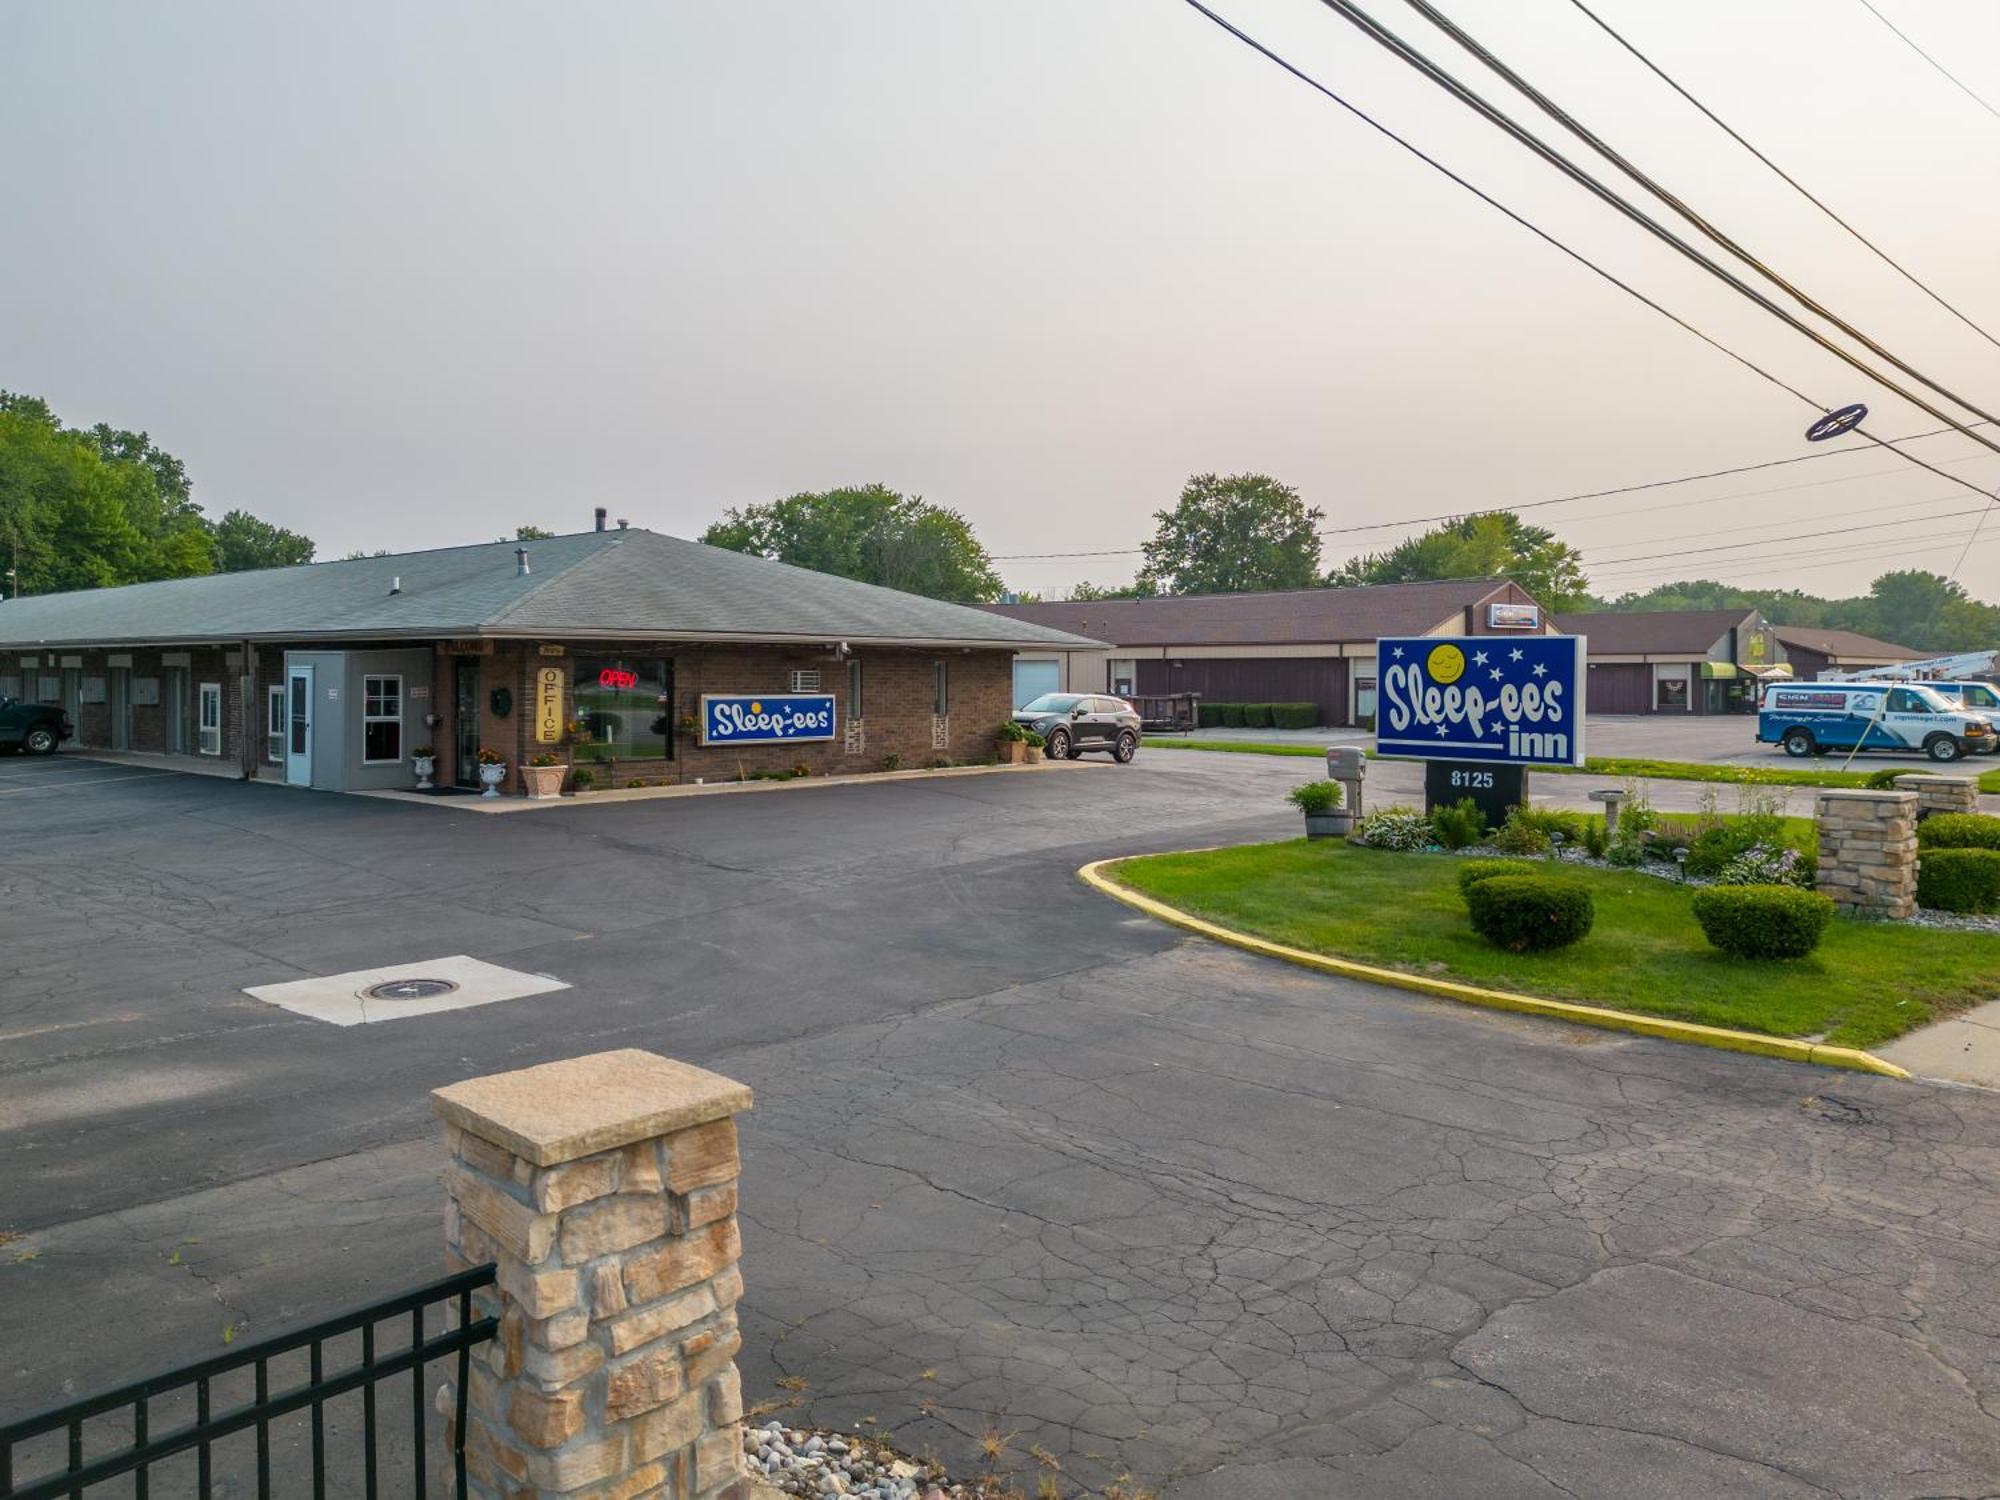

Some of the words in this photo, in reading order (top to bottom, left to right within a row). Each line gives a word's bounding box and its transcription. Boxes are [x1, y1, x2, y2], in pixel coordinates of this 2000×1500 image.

[599, 667, 639, 689] OPEN
[543, 670, 557, 741] OFFICE
[1384, 662, 1563, 738] Sleep-ees
[713, 703, 829, 737] Sleep-ees
[1508, 724, 1568, 759] inn
[1451, 770, 1494, 788] 8125
